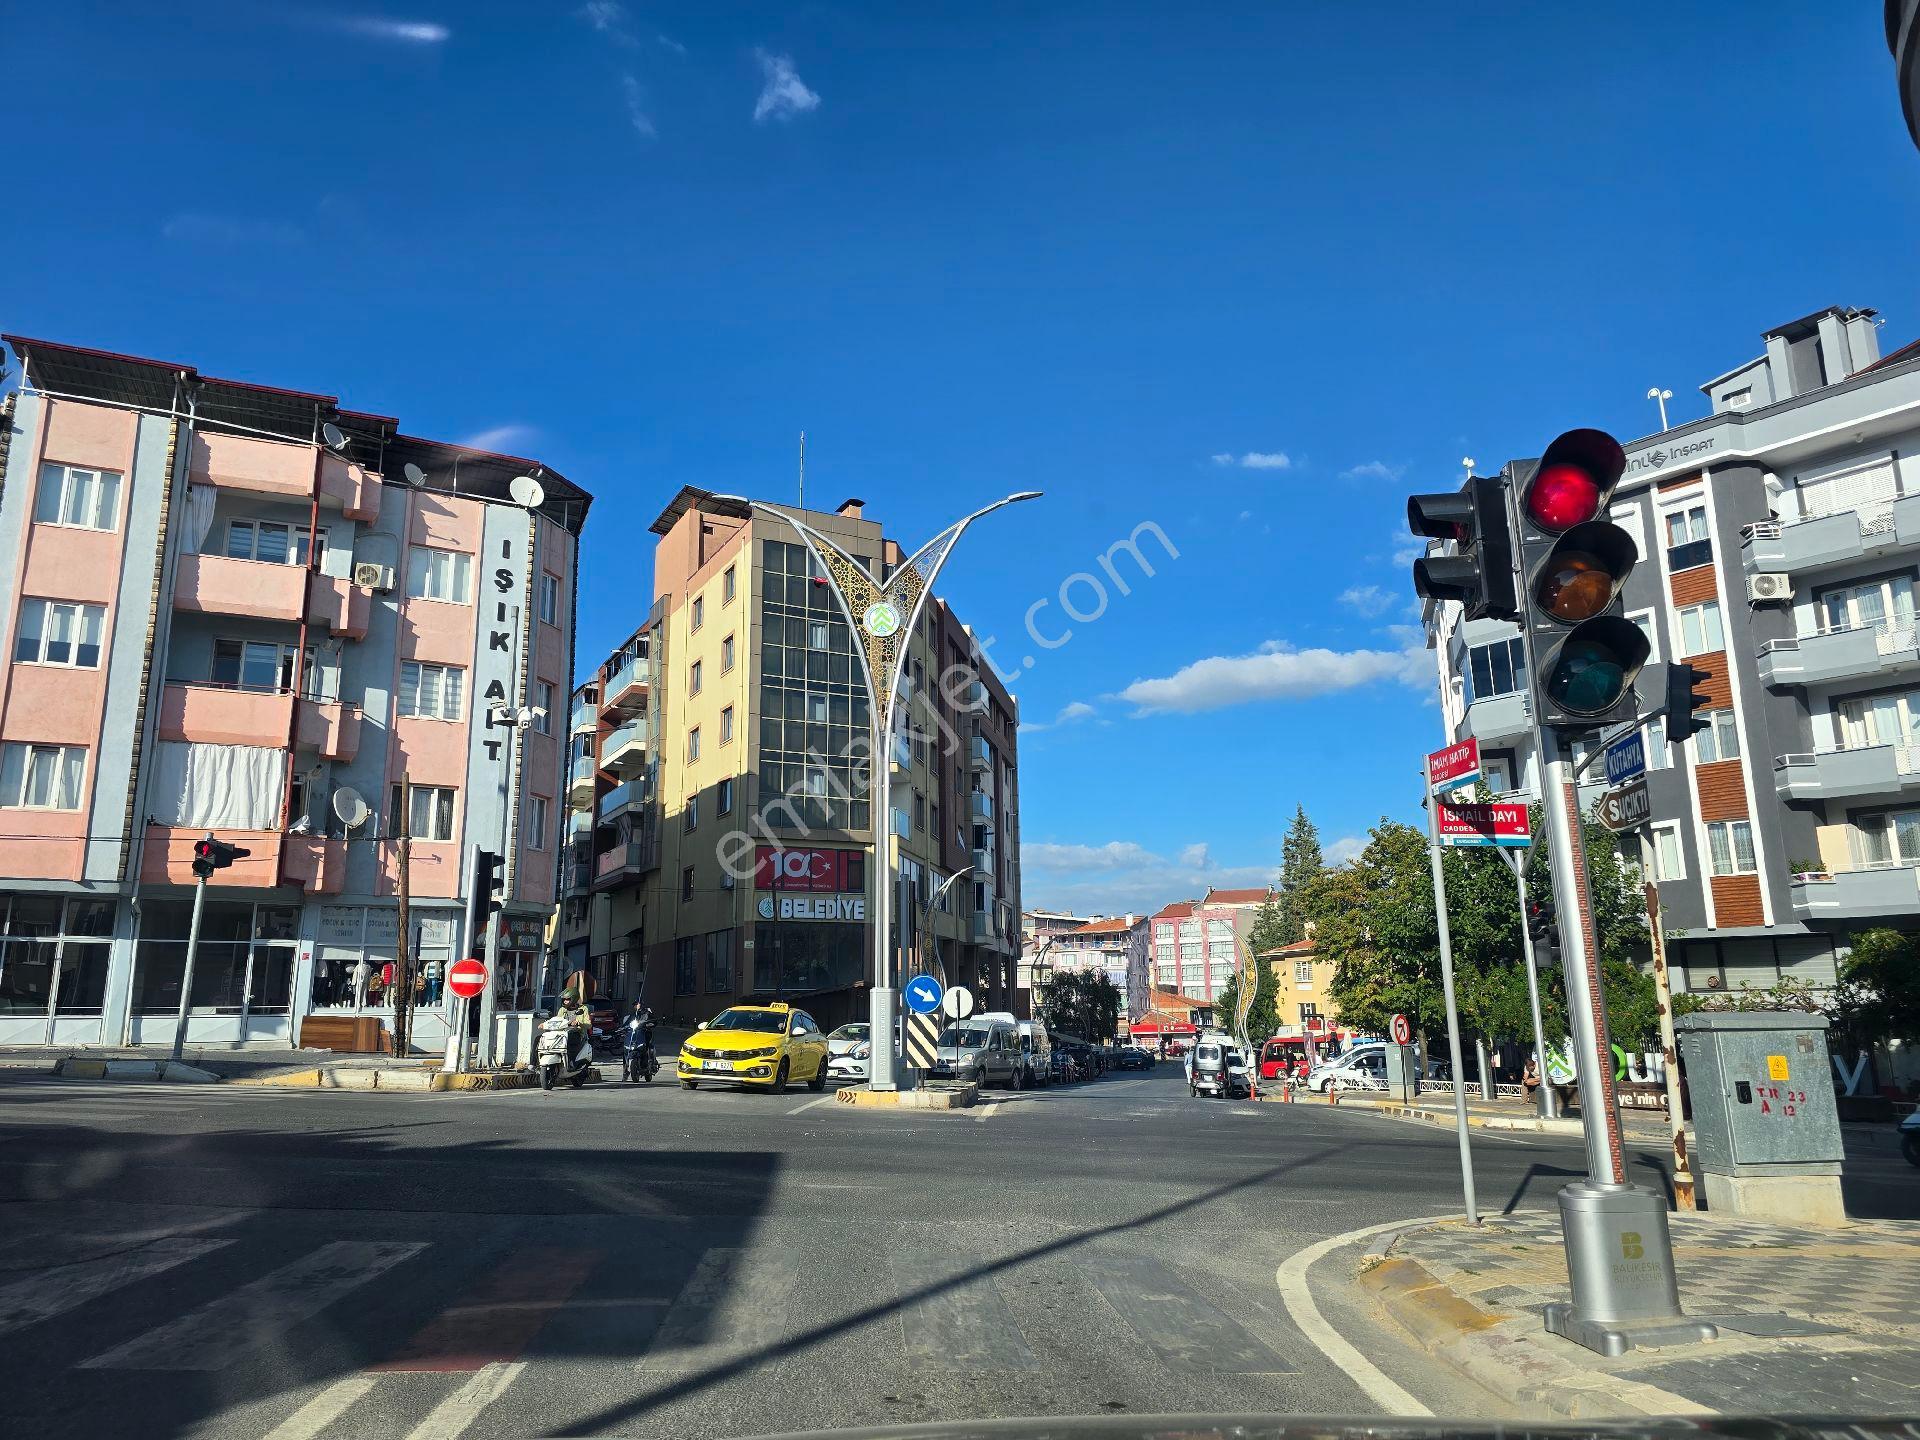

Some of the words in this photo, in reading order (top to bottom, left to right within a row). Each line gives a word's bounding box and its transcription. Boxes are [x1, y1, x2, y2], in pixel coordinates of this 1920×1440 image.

[489, 539, 515, 653] IŞIK
[1448, 746, 1470, 765] HATİP
[1608, 742, 1643, 778] KÜTAHYA
[1443, 807, 1486, 822] İSMAİL
[1488, 810, 1517, 823] DAYI
[780, 894, 865, 920] BELEDİYE
